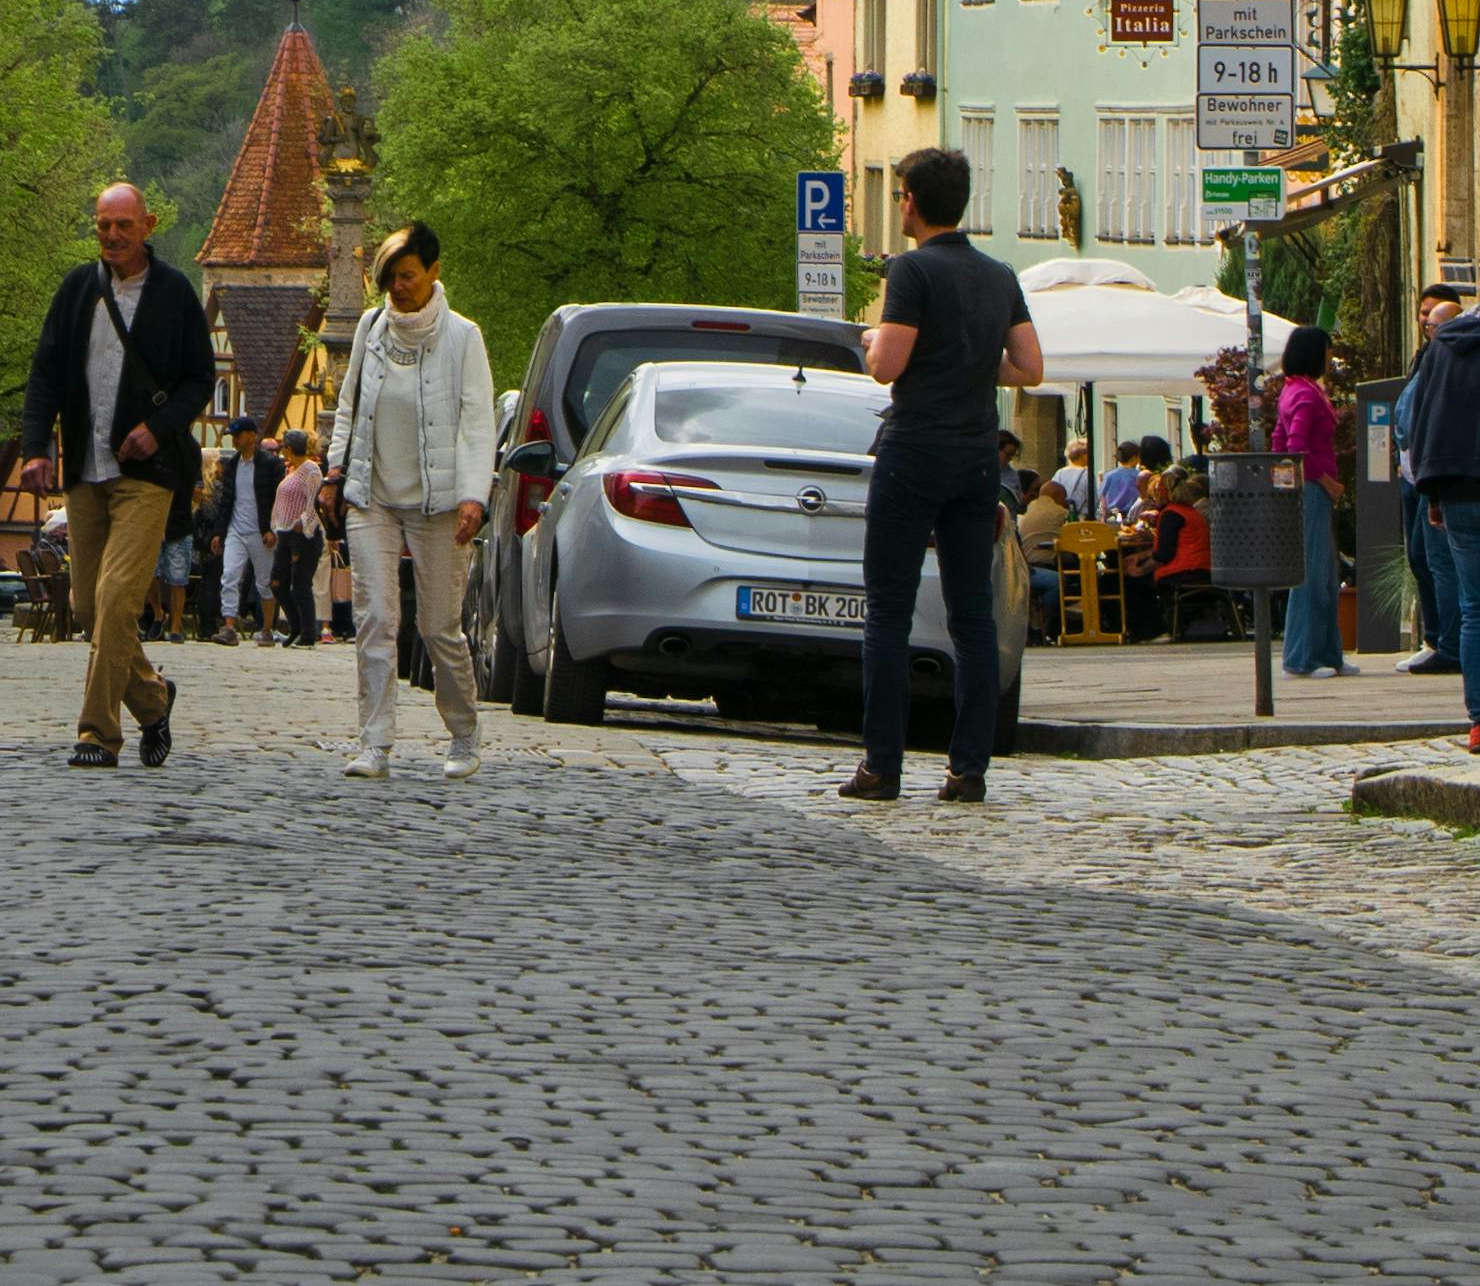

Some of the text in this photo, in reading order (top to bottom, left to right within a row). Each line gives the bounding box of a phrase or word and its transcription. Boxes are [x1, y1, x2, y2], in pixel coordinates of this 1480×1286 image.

[1120, 3, 1165, 13] Pizzeria
[1233, 7, 1257, 21] mit
[1114, 17, 1170, 33] Italia
[1206, 25, 1286, 40] Parkschein
[1214, 61, 1277, 83] 9-18 h
[1207, 98, 1282, 112] Bewohner
[1232, 131, 1257, 145] frei
[1205, 172, 1278, 187] Handy-Parken
[805, 180, 830, 229] P
[814, 241, 826, 249] mit
[800, 250, 840, 260] Parkschein
[805, 273, 836, 286] 9-18 h
[802, 293, 839, 304] Bewohner
[1371, 405, 1386, 423] P
[752, 592, 790, 613] ROT
[805, 595, 830, 617] BK
